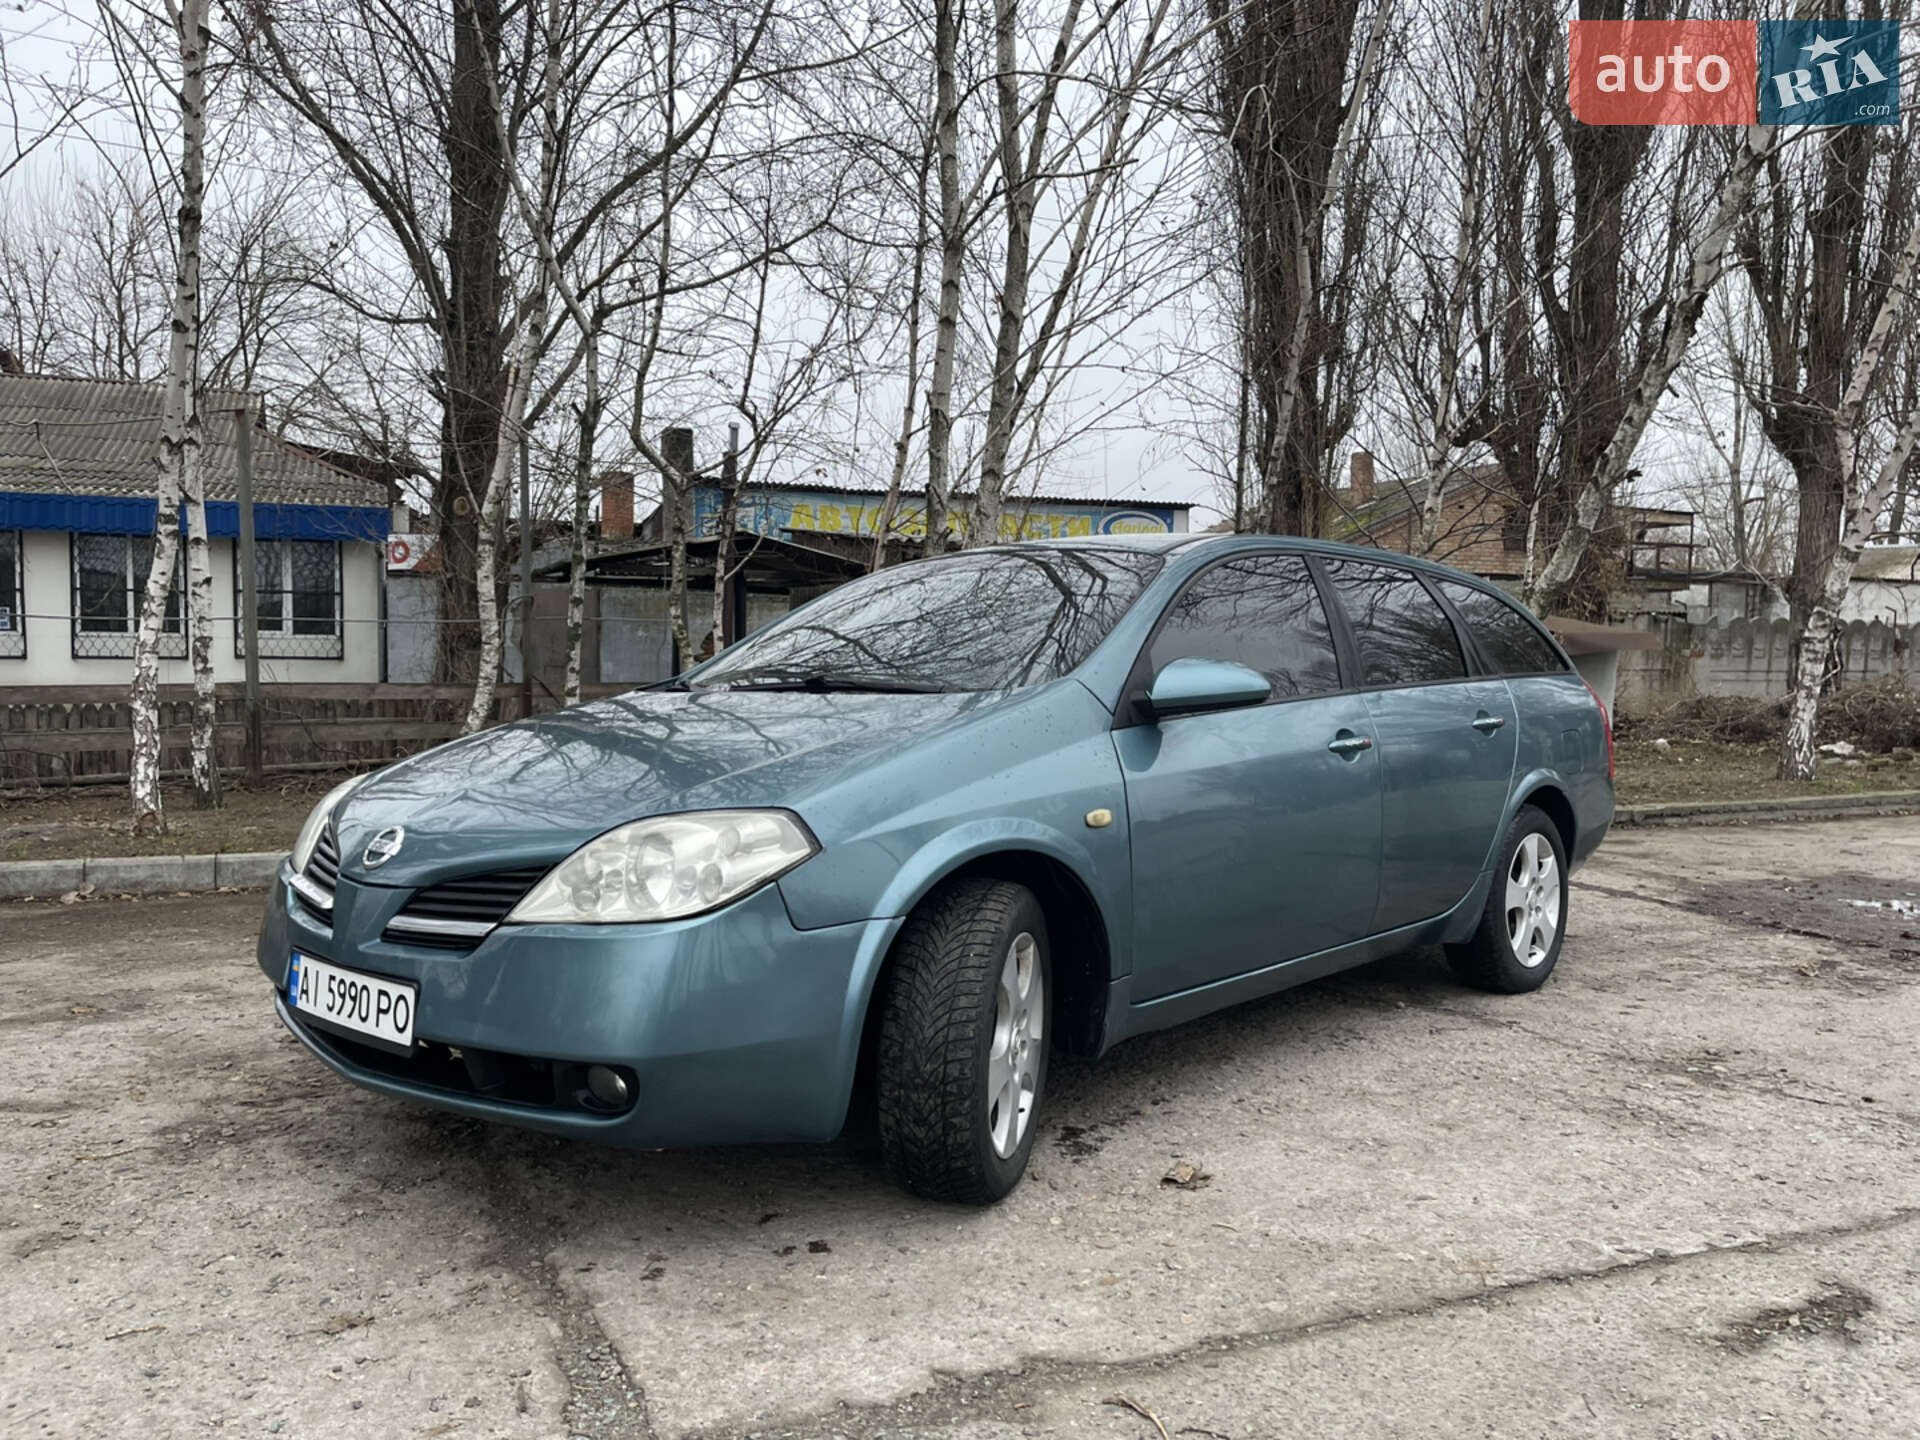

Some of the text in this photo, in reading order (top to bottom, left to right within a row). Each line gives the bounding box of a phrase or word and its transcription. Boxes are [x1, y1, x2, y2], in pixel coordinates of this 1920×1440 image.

[300, 966, 410, 1034] AI 5990 PO
